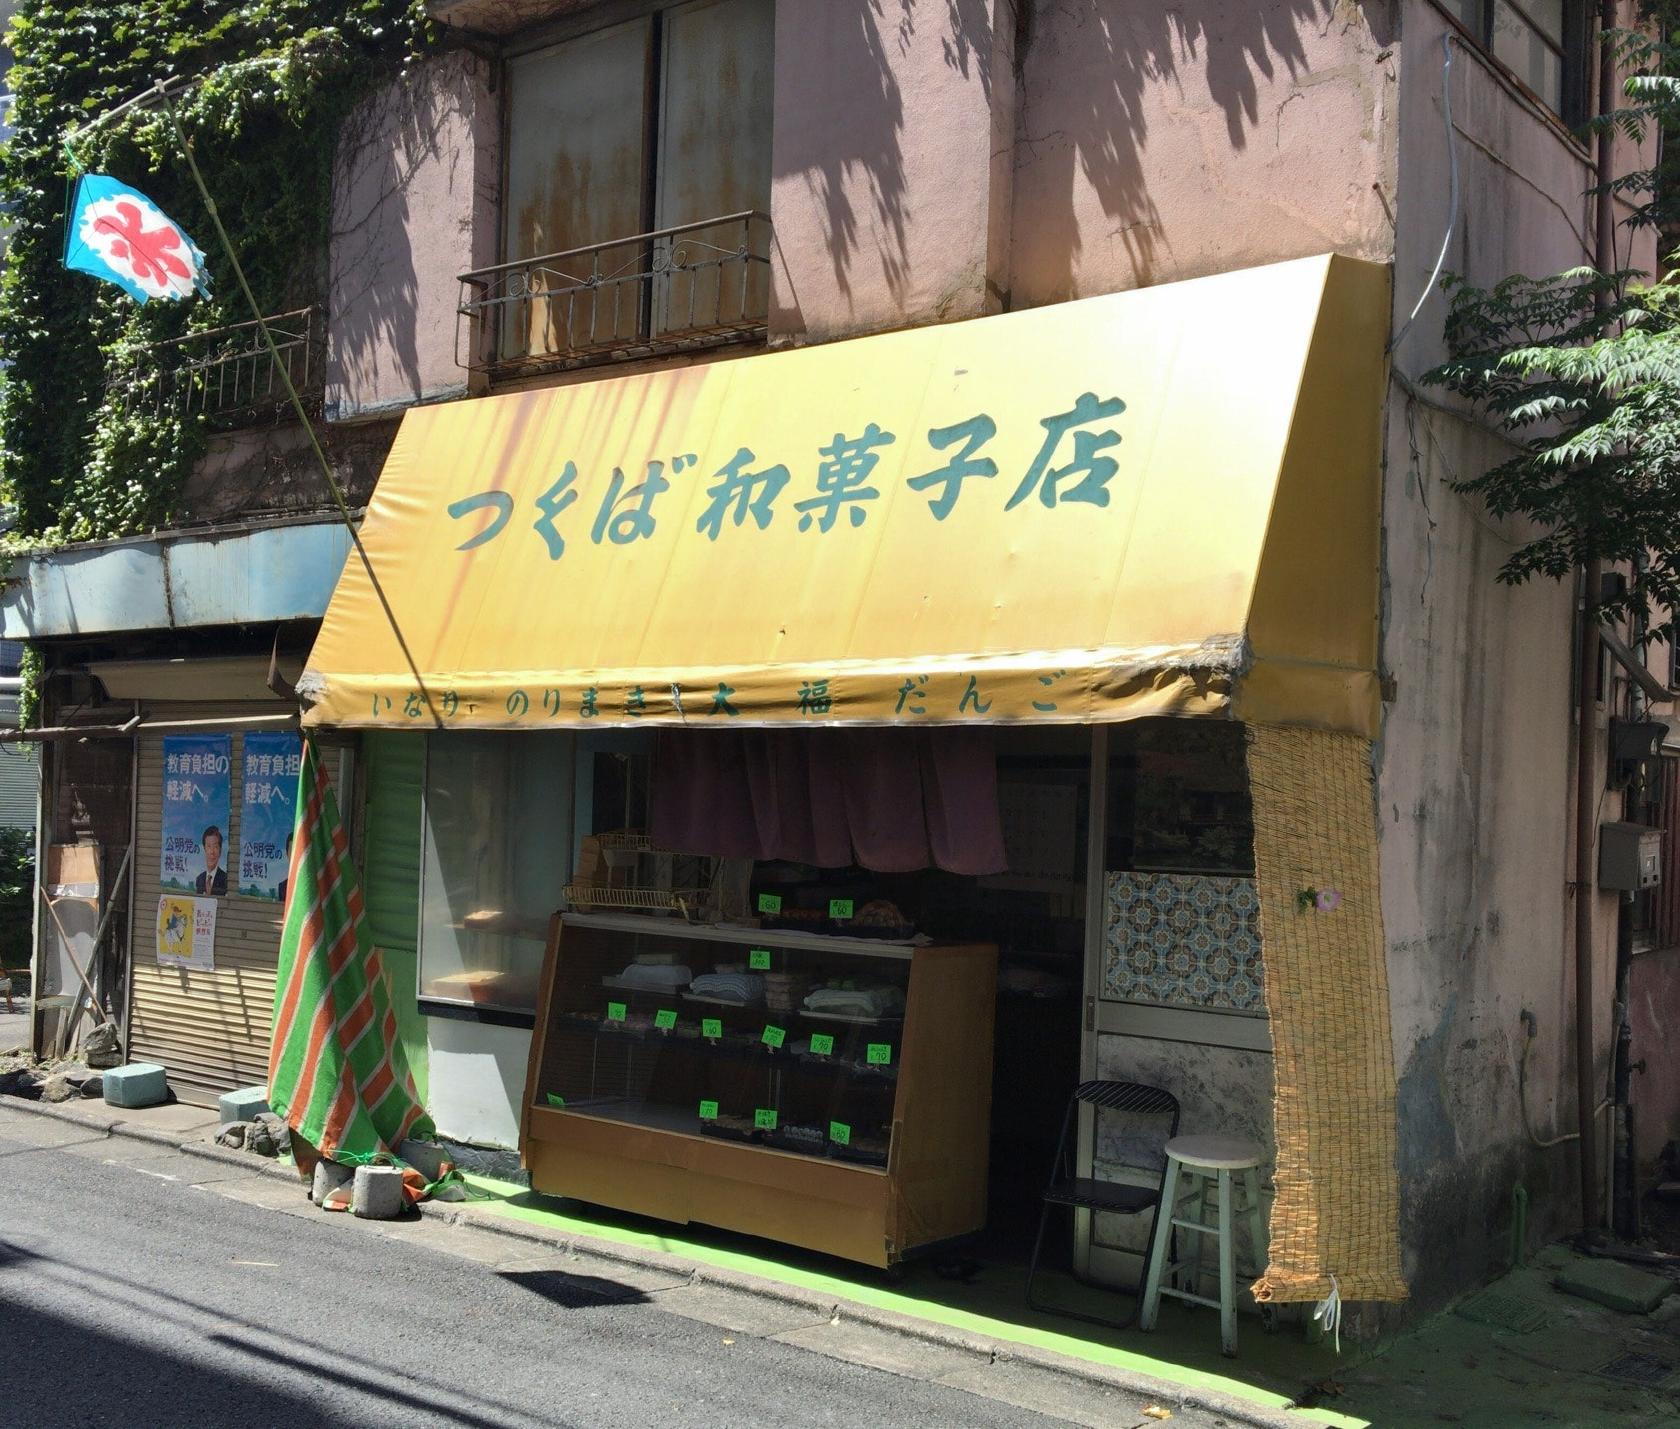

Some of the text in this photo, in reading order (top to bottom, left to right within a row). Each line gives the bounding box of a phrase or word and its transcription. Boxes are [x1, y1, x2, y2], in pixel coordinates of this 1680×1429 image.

[448, 392, 1127, 561] つくば和菓子店
[709, 679, 832, 716] 大福
[894, 669, 1066, 715] だんご
[167, 753, 229, 775] 教育負担の
[166, 780, 208, 802] 軽減へ。
[245, 782, 290, 805] 軽減へ。
[165, 836, 200, 854] 公明党の
[243, 842, 282, 860] 公明党の
